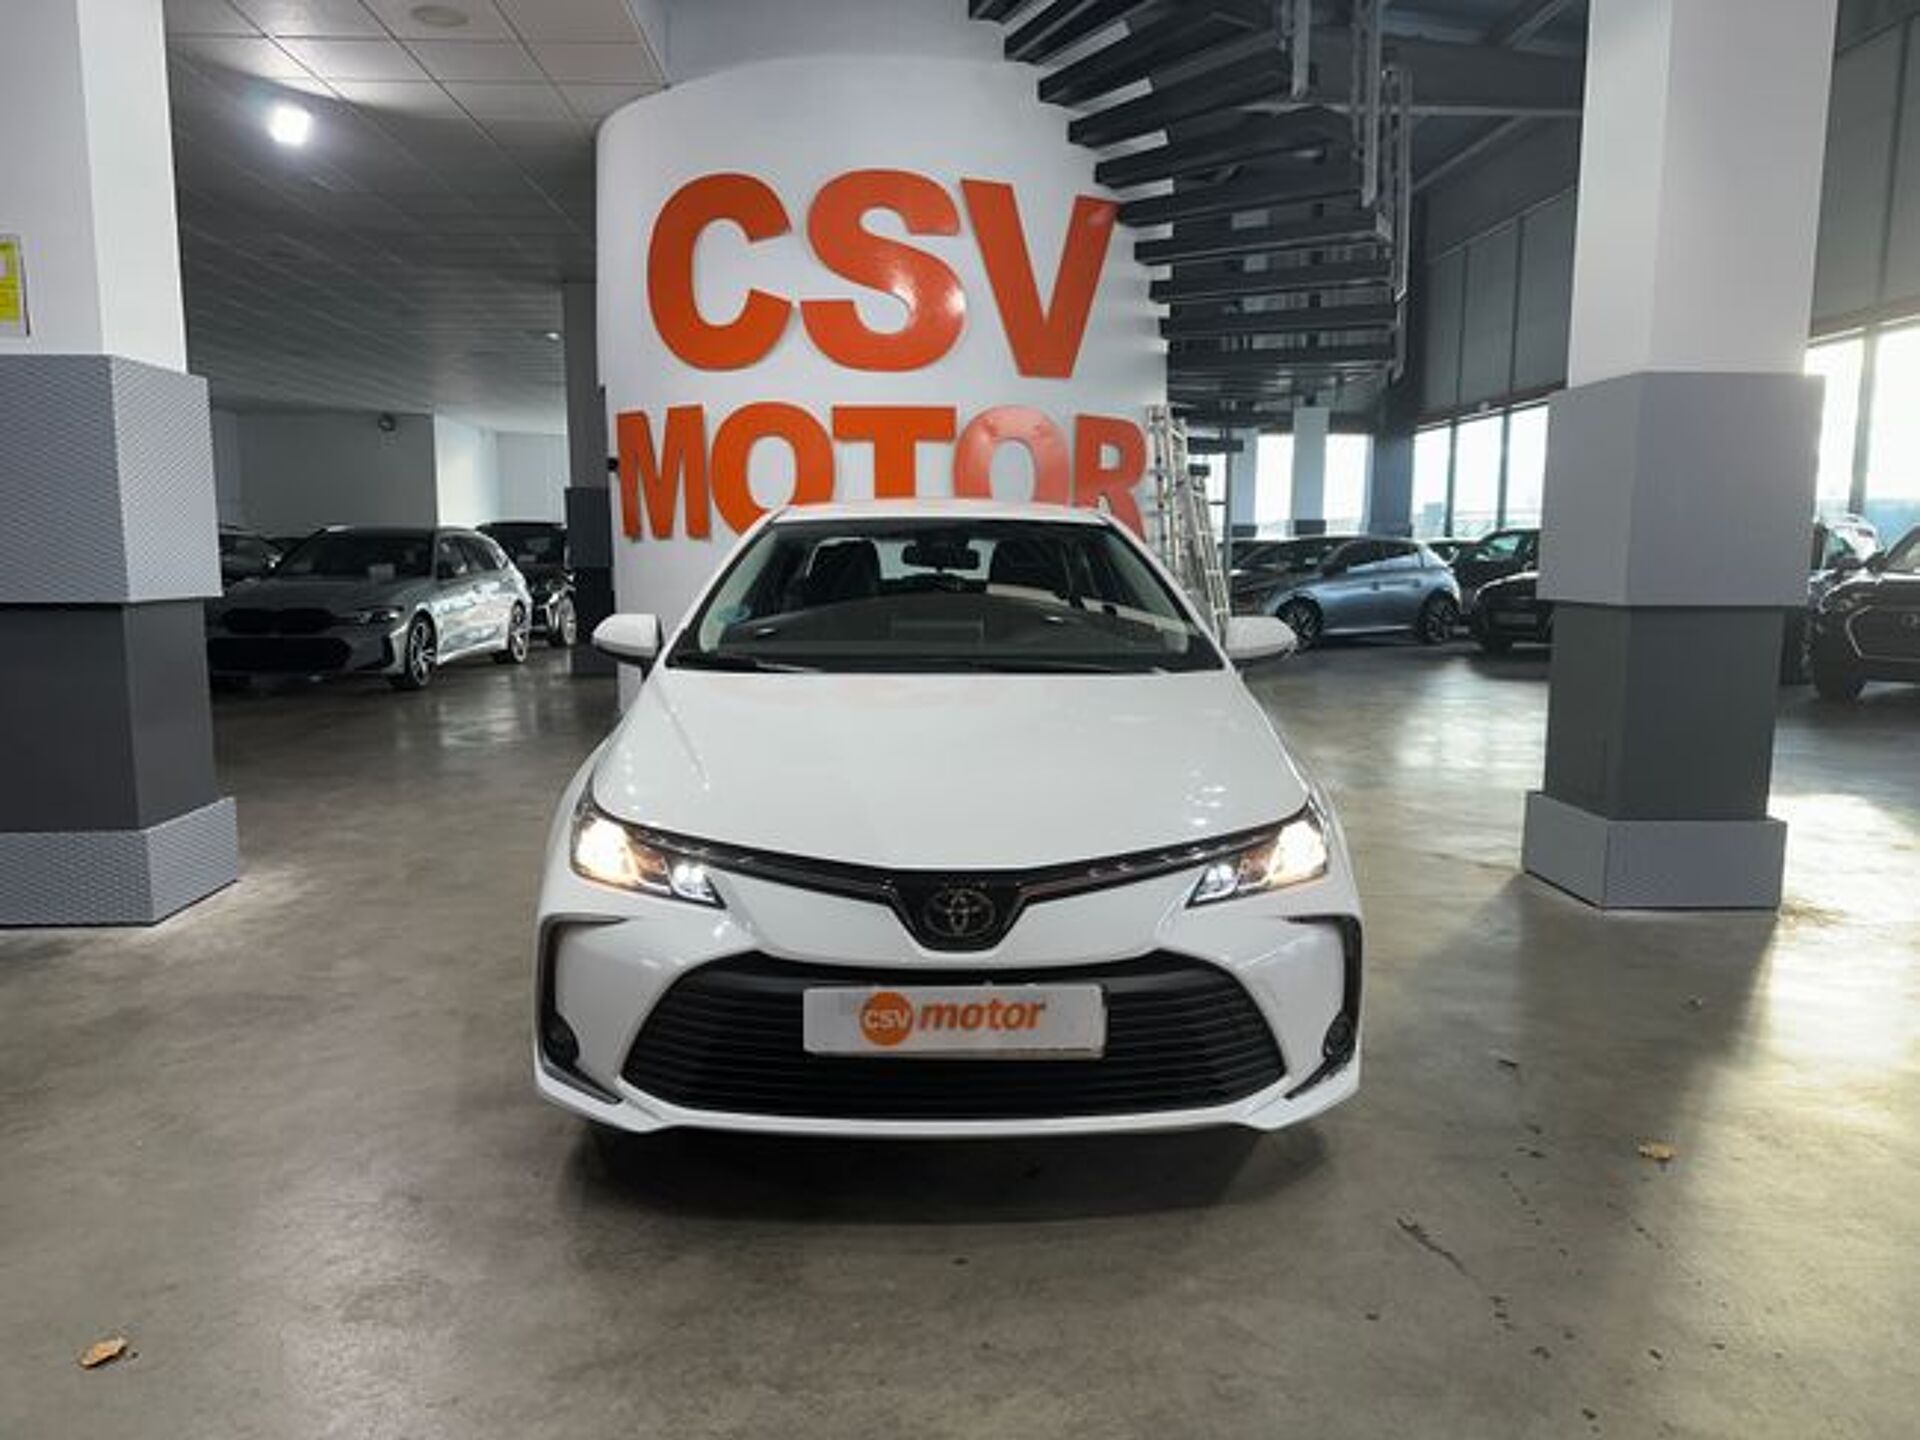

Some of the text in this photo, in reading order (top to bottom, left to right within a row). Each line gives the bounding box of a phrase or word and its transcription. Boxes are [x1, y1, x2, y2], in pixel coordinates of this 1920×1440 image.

[647, 169, 1118, 378] CSV
[616, 402, 1147, 541] MOTOR
[863, 998, 1046, 1031] CSV motor
